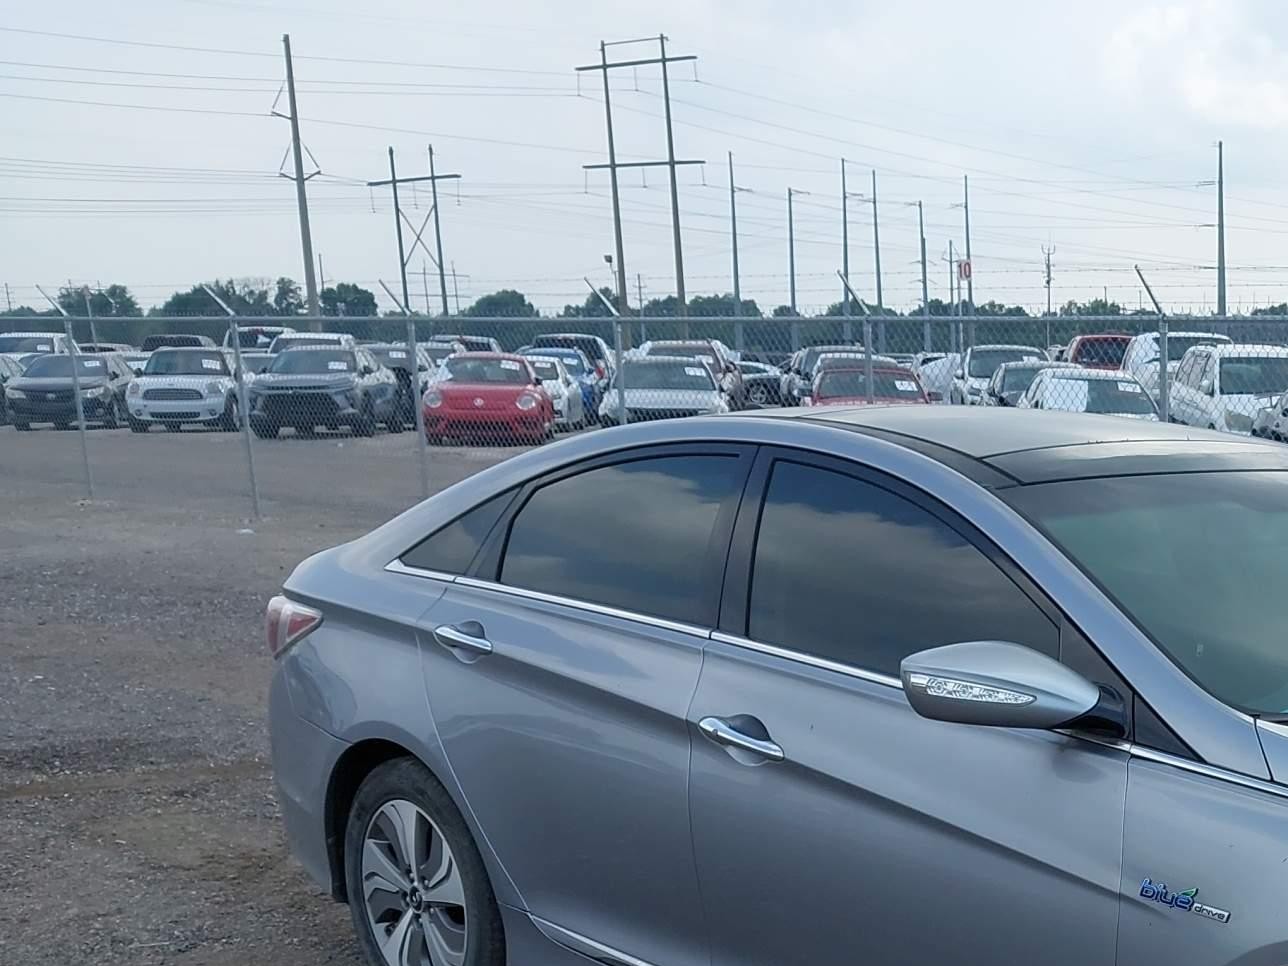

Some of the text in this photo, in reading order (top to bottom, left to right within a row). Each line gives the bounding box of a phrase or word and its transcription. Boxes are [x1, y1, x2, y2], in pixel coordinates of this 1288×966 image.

[958, 262, 971, 278] 10
[1140, 878, 1228, 921] blue drive
